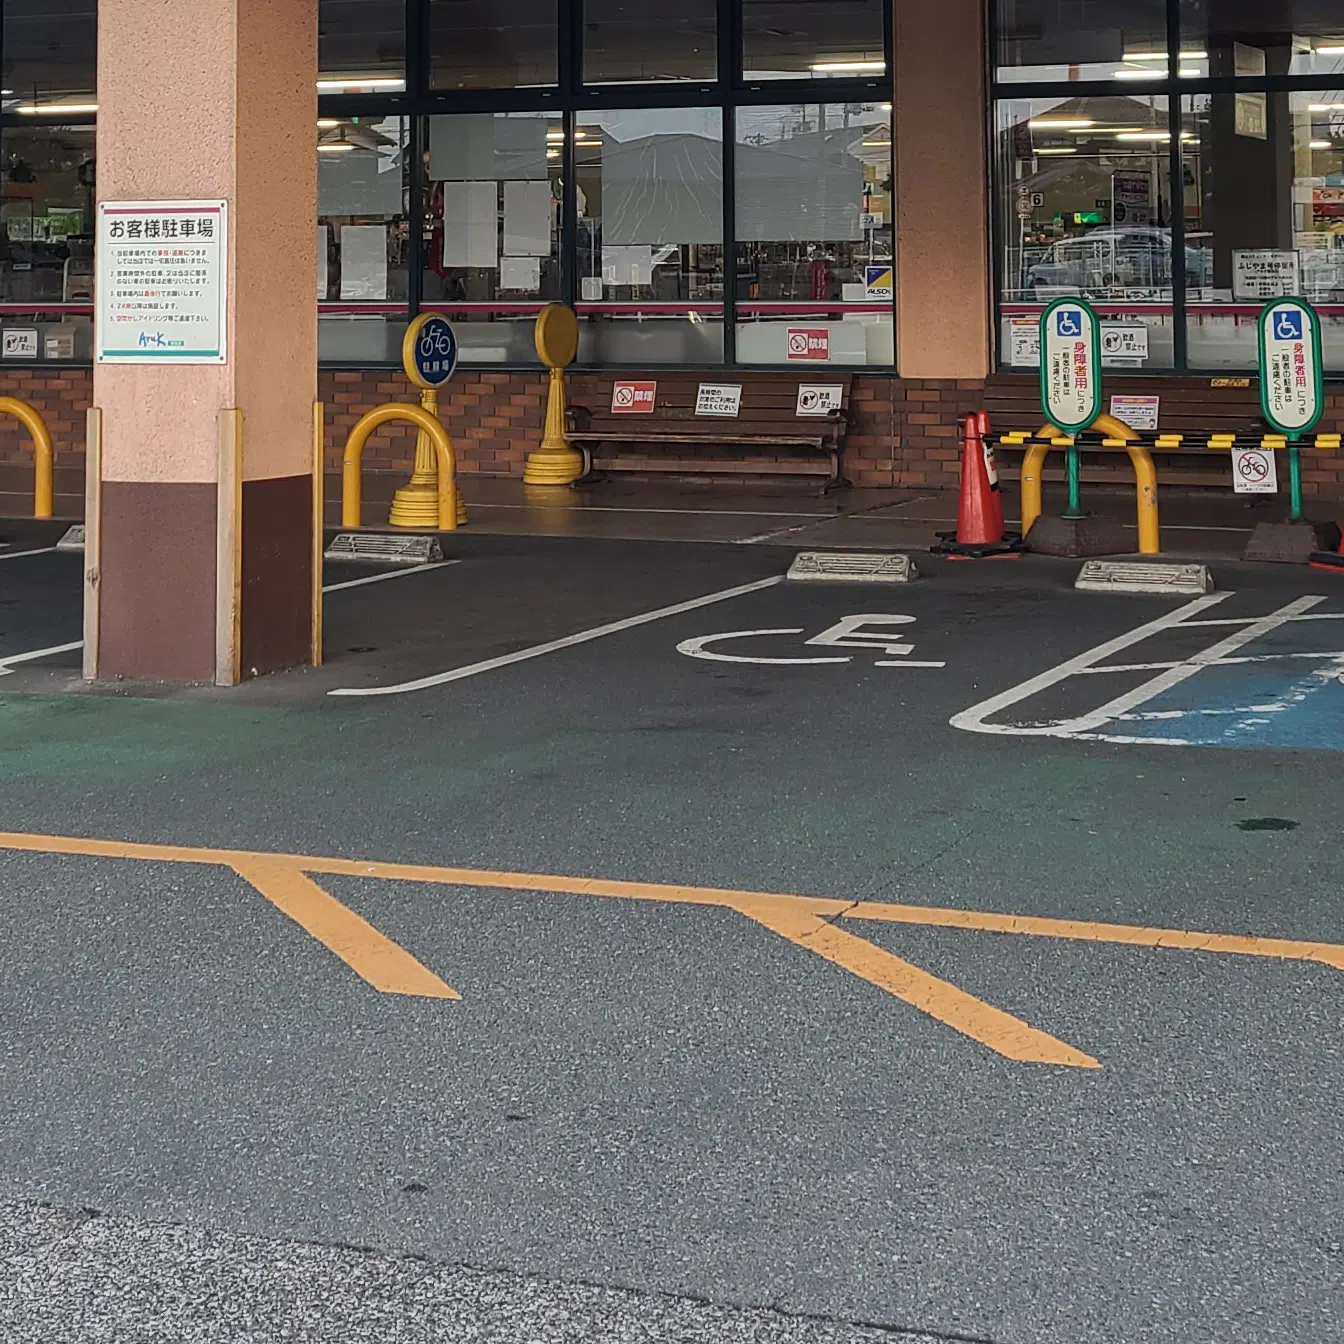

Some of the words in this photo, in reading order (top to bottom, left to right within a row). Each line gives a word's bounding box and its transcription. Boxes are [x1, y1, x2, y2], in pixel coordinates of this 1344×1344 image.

[1033, 194, 1041, 205] 6
[109, 218, 214, 238] お客様駐車場
[1122, 333, 1134, 342] 飲酒
[1125, 343, 1146, 351] 禁止です
[422, 359, 450, 373] 駐輪場
[1052, 352, 1062, 405] ご遠慮ください
[1062, 347, 1071, 396] 一般者の駐車は
[1073, 341, 1088, 413] 身障者用につき
[1271, 354, 1284, 411] ご遠慮ください
[1280, 348, 1292, 402] 一般者の駐車は
[1293, 342, 1306, 415] 身障者用につき
